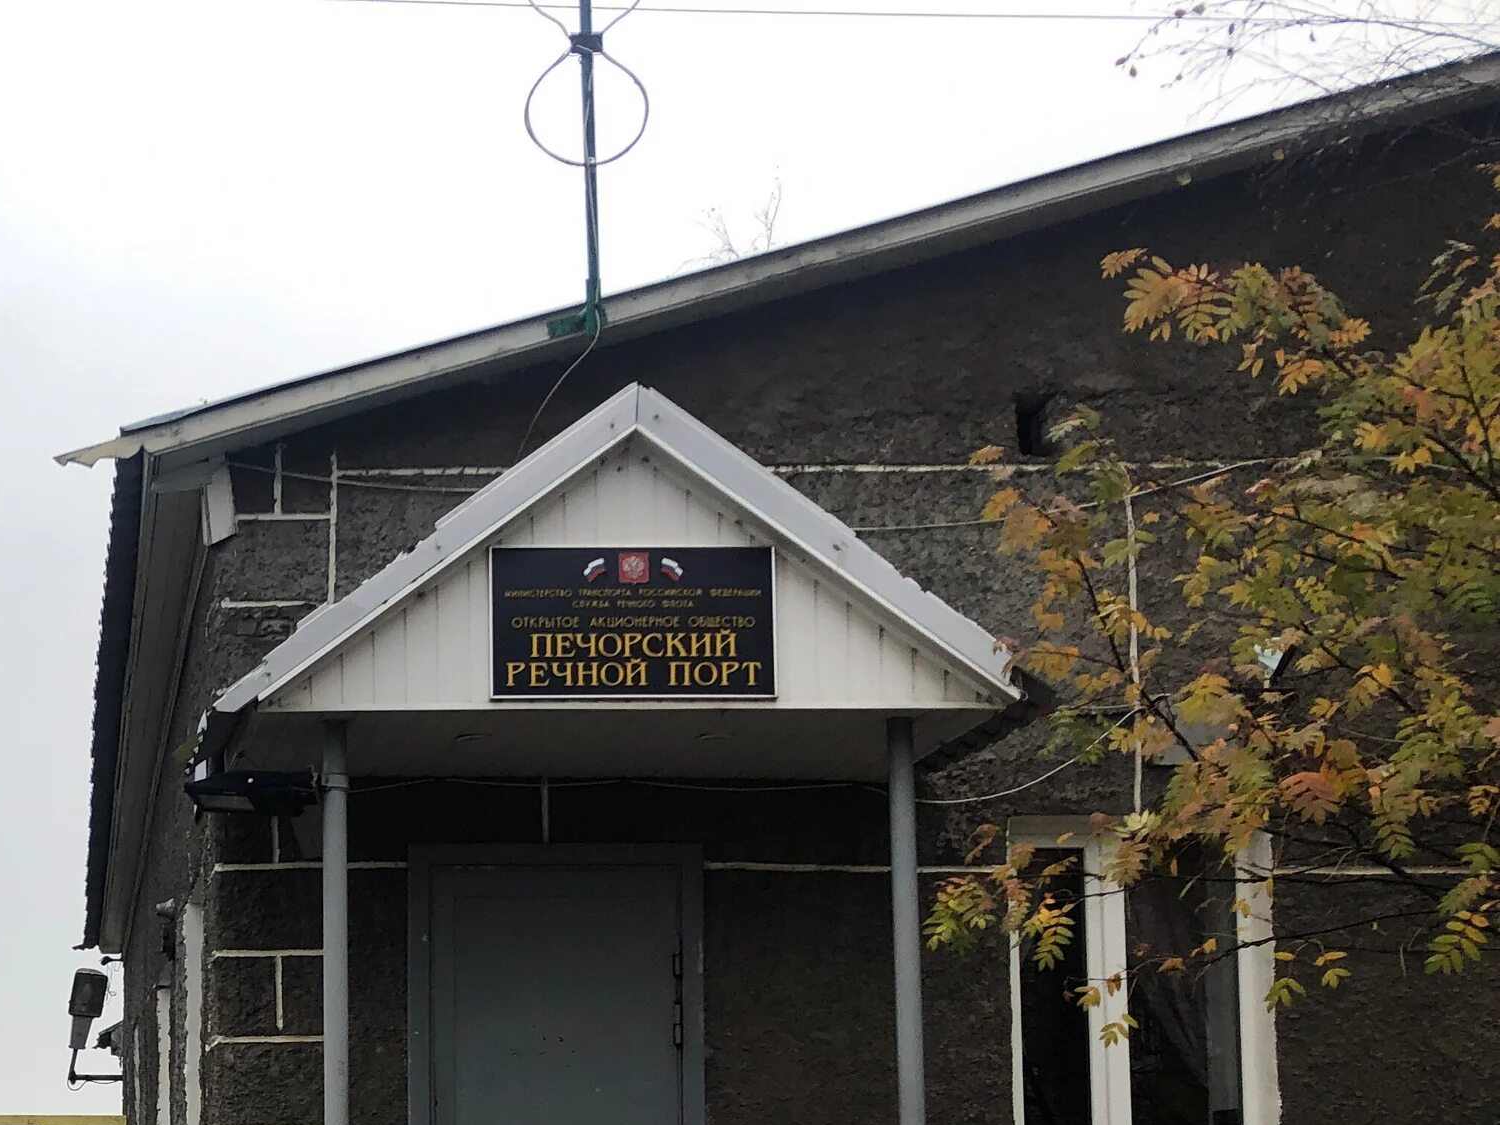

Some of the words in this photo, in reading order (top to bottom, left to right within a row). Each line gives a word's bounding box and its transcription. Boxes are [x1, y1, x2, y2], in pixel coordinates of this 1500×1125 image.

[511, 616, 580, 629] ОТКРЫТОЕ
[589, 616, 680, 628] АКЦИОНЕРНОЕ
[688, 616, 756, 628] ОБЩЕСТВО
[530, 629, 738, 658] ПЕЧОРСКИЙ
[506, 658, 649, 687] РЕЧНОЙ
[667, 661, 762, 686] ПОРТ
